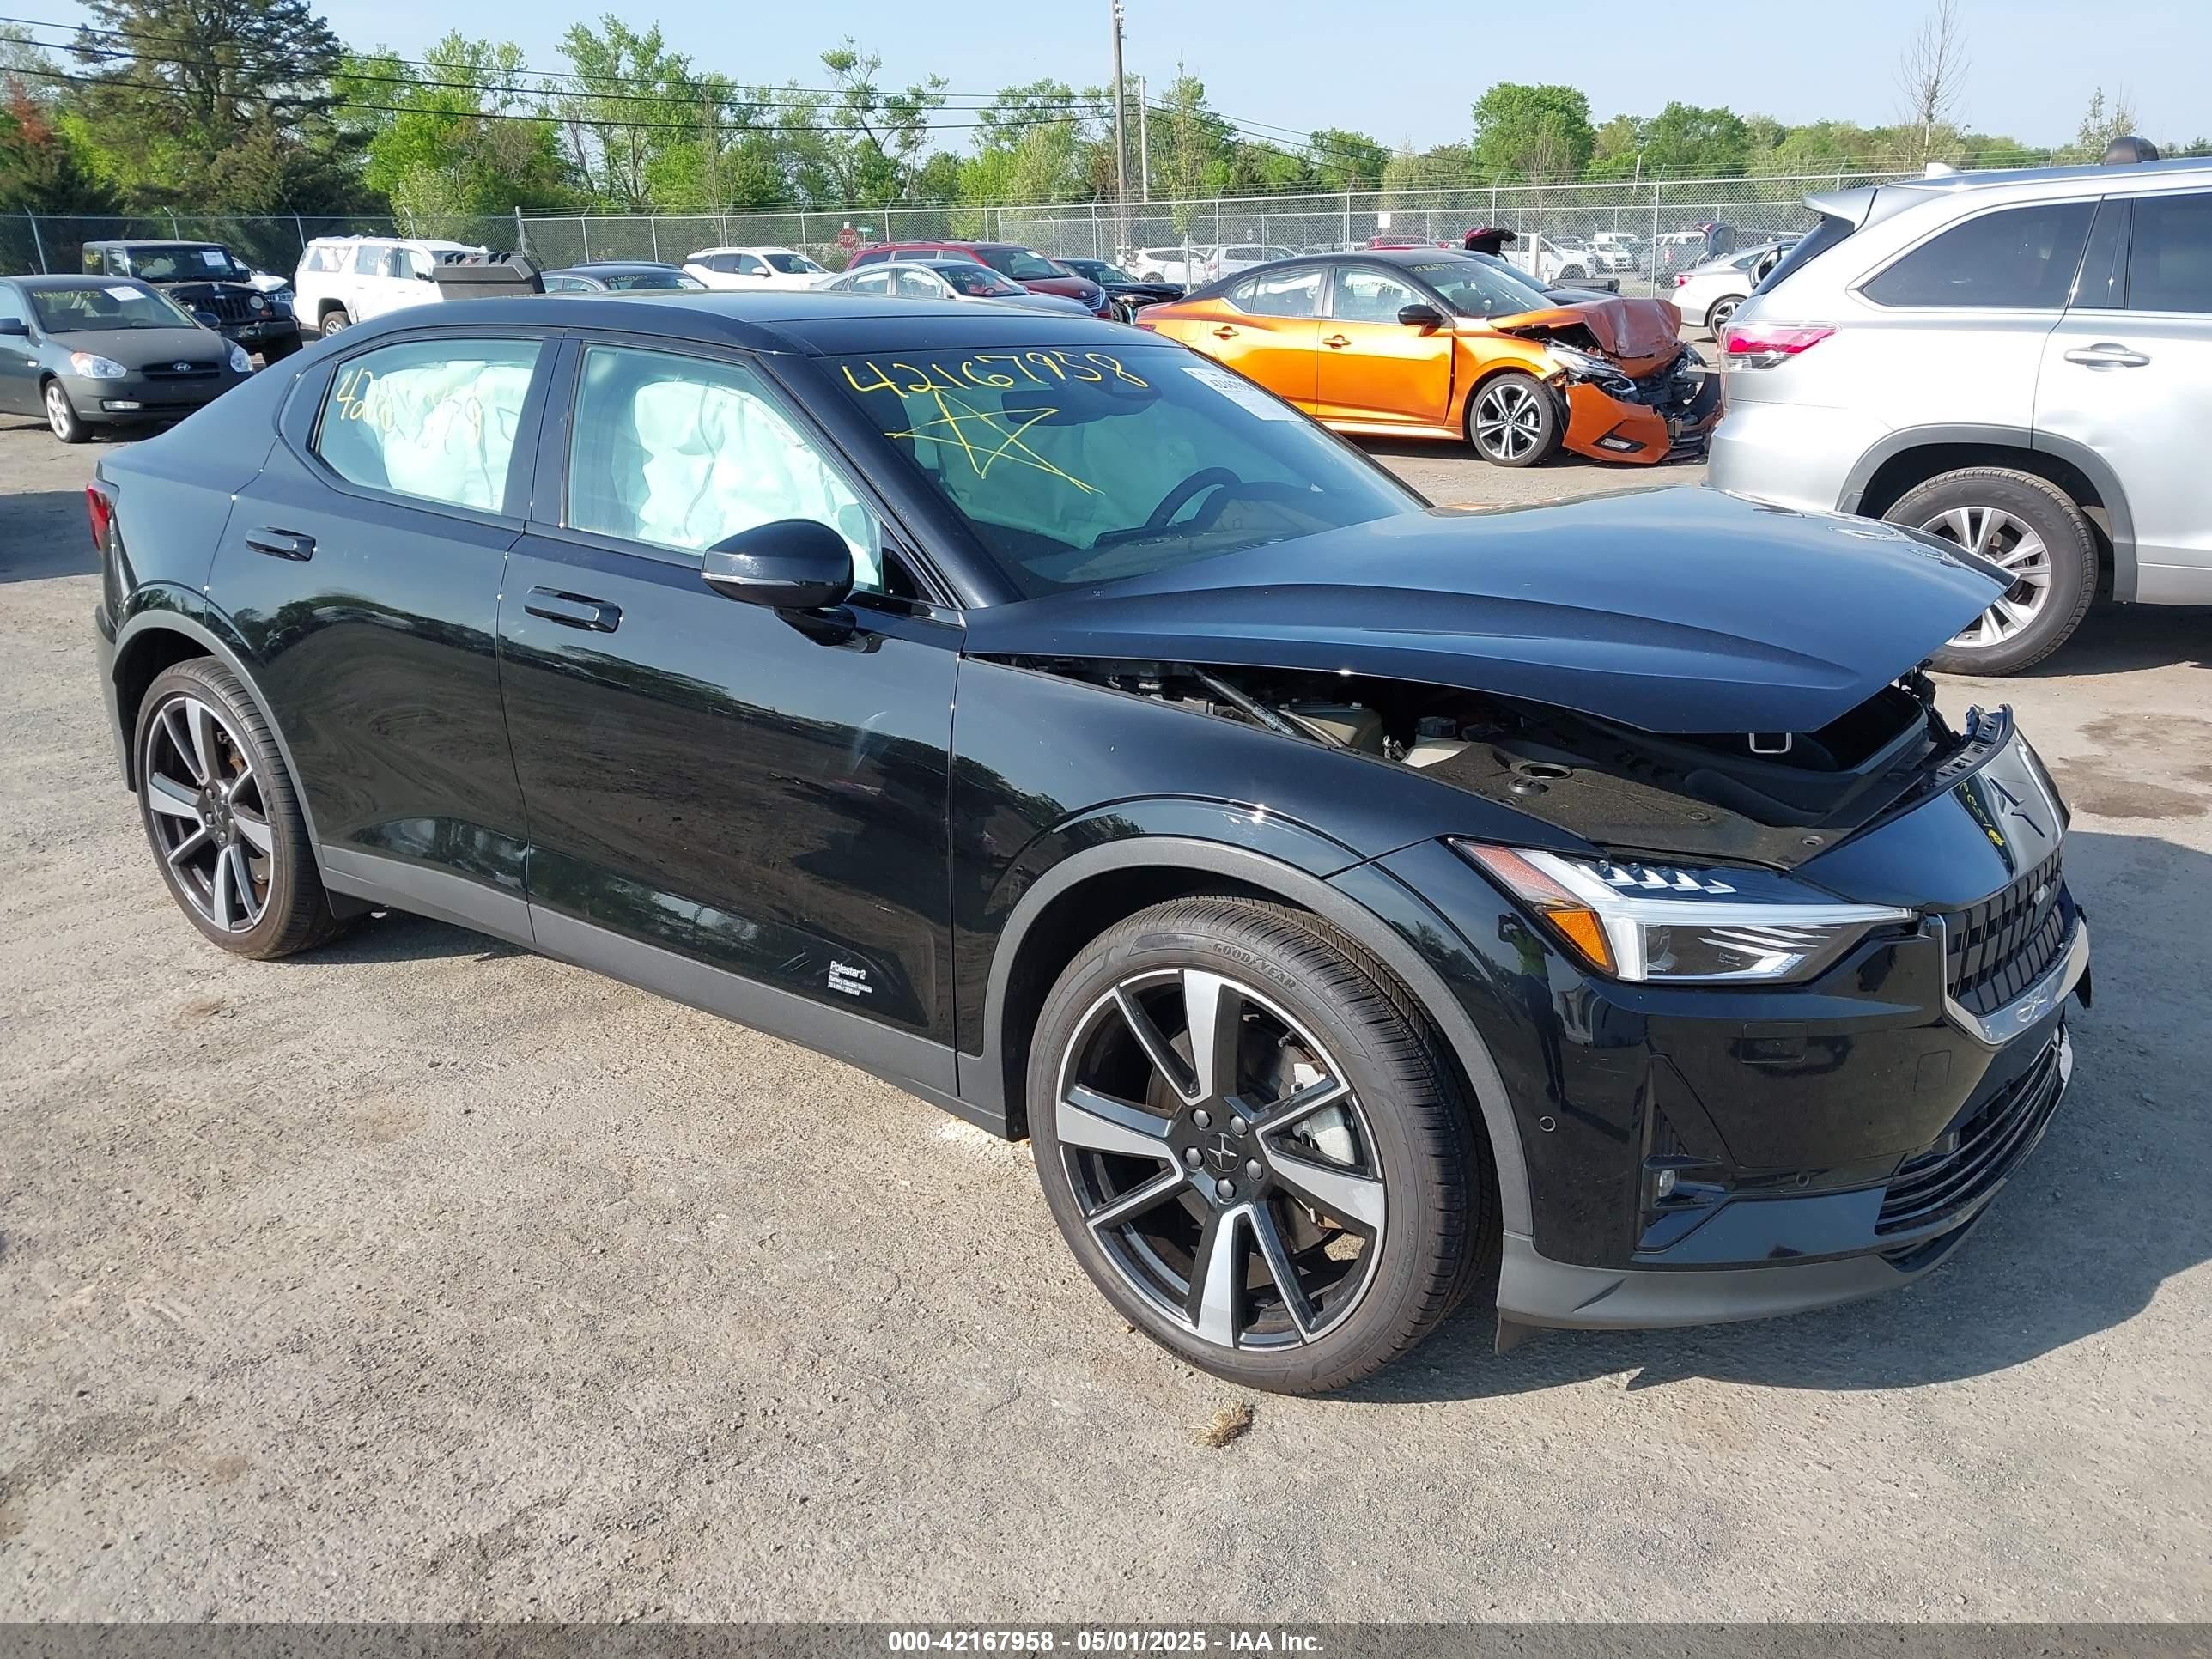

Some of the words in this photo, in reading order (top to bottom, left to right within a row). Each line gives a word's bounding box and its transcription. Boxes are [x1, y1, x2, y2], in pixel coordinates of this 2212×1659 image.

[840, 234, 856, 243] STOP
[842, 350, 1149, 398] 42167958
[830, 960, 860, 978] Polestar
[860, 969, 866, 980] 2
